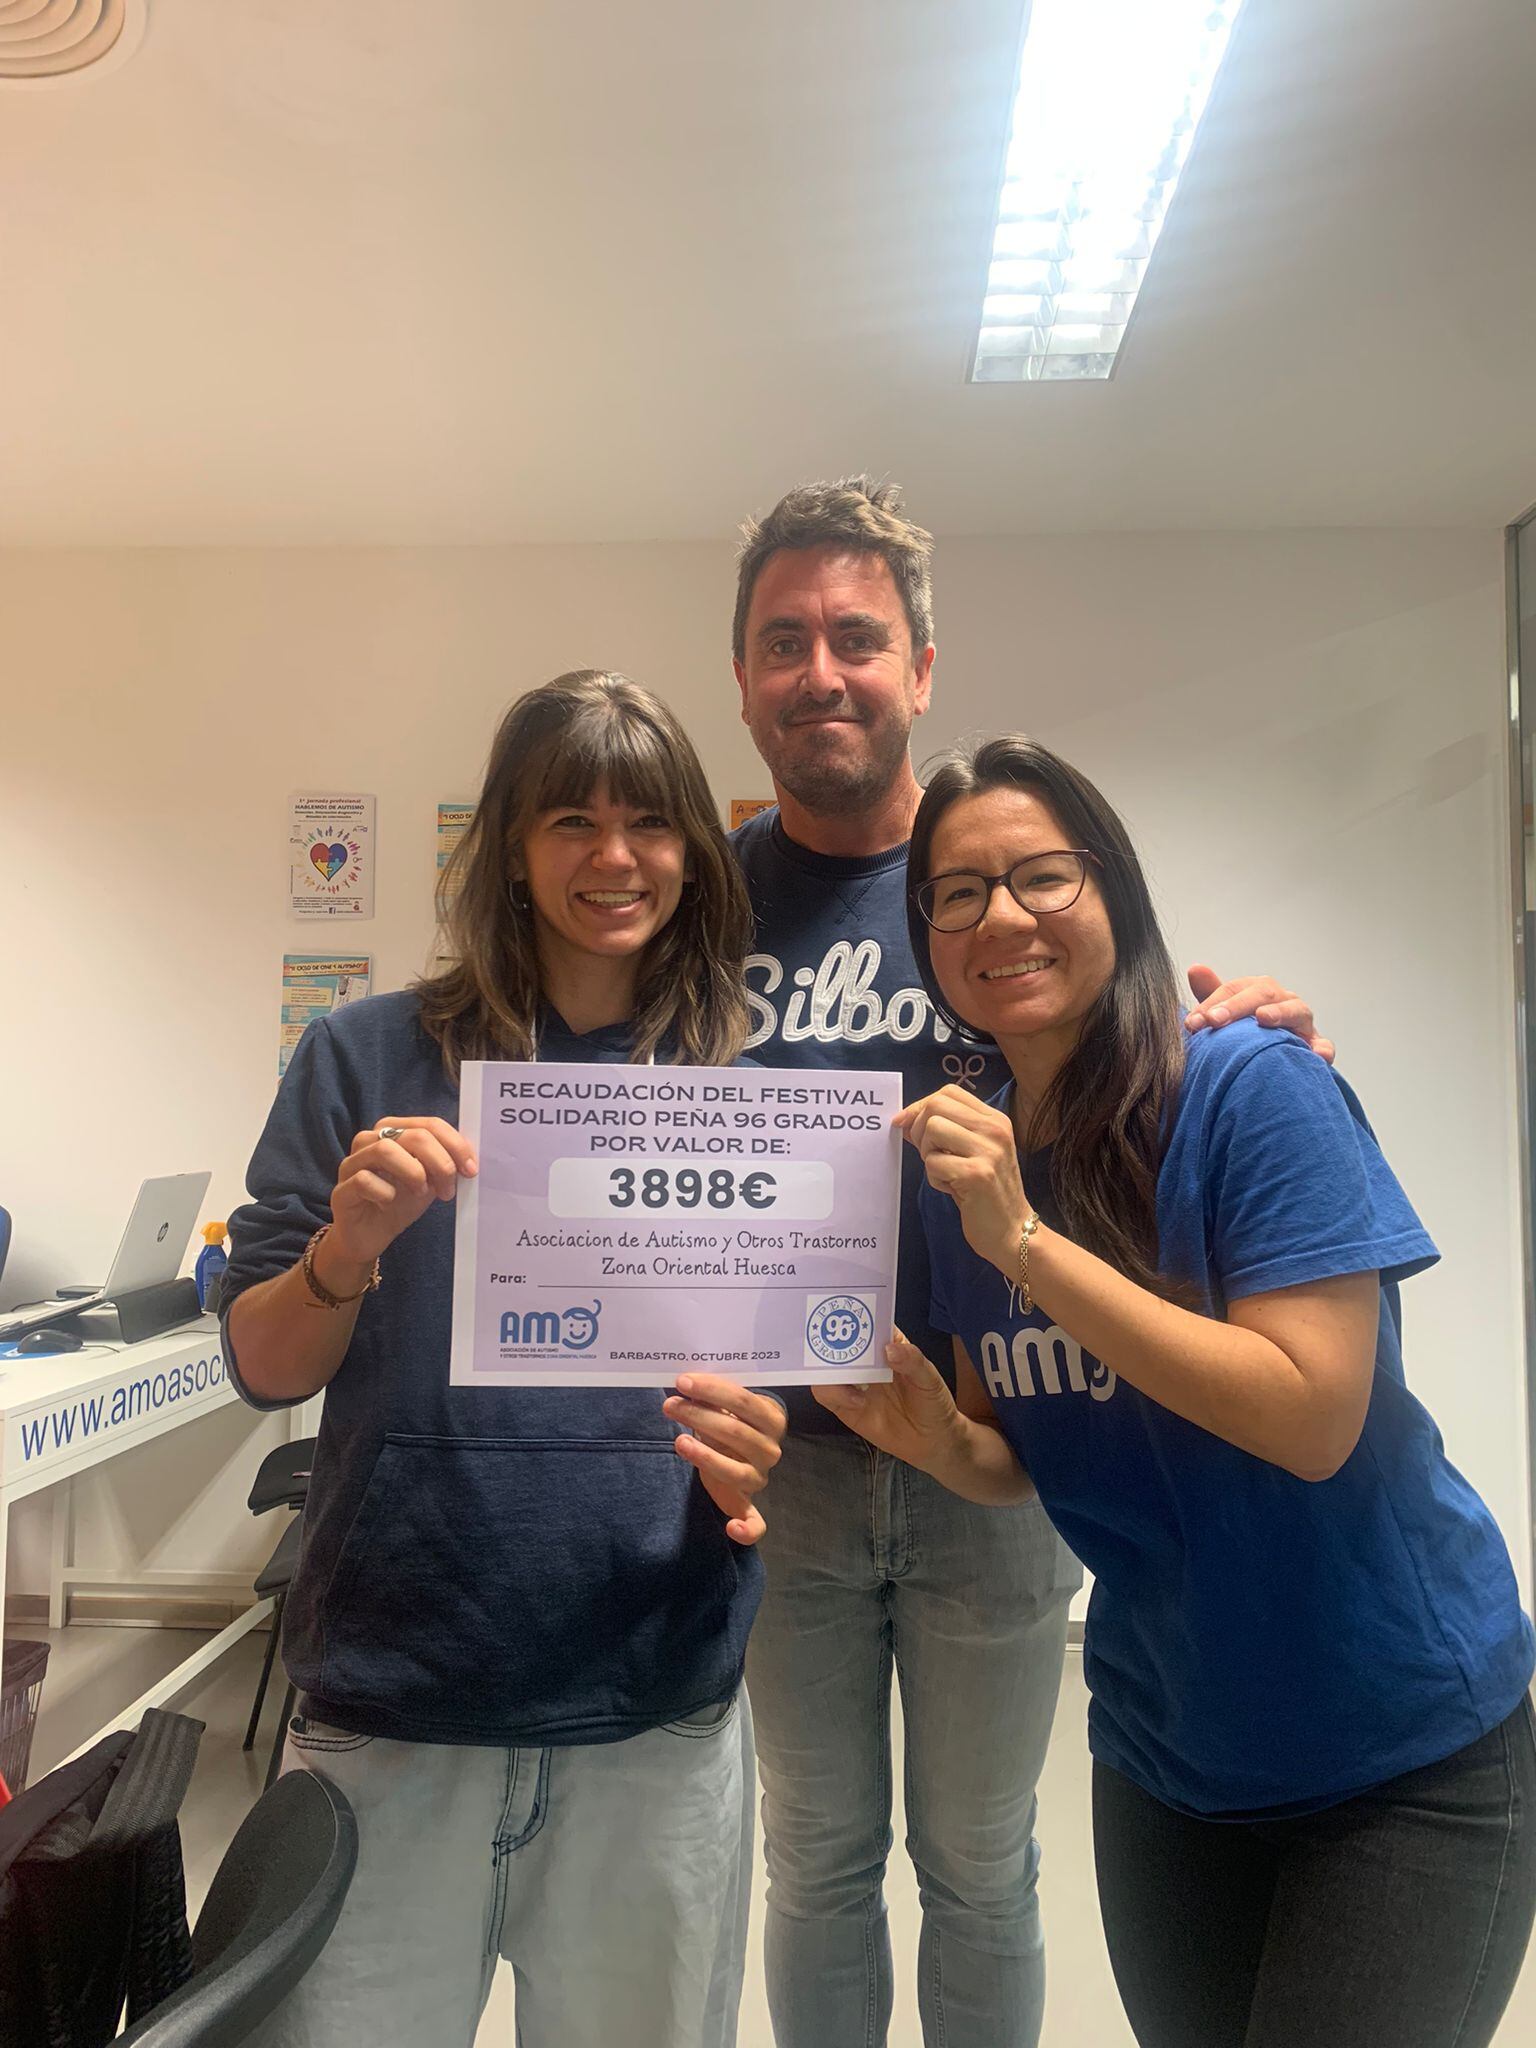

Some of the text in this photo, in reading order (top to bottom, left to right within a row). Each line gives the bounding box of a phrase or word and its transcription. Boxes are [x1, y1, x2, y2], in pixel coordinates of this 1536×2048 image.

[500, 1082, 883, 1105] RECAUDACIÓN DEL FESTIVAL
[500, 1108, 882, 1130] SOLIDARIO PEÑA 96 GRADOS
[590, 1136, 791, 1154] POR VALOR DE:
[609, 1168, 777, 1209] 3898€
[516, 1229, 877, 1254] Asociacion de Autismo y Otros Trastornos
[602, 1257, 796, 1276] Zona Oriental Huesca
[490, 1273, 527, 1284] Para:
[816, 1298, 865, 1320] PEÑA
[500, 1299, 602, 1350] AMO
[610, 1351, 781, 1361] BARBASTRO, OCTUBRE 2023
[811, 1336, 867, 1361] GRADOS
